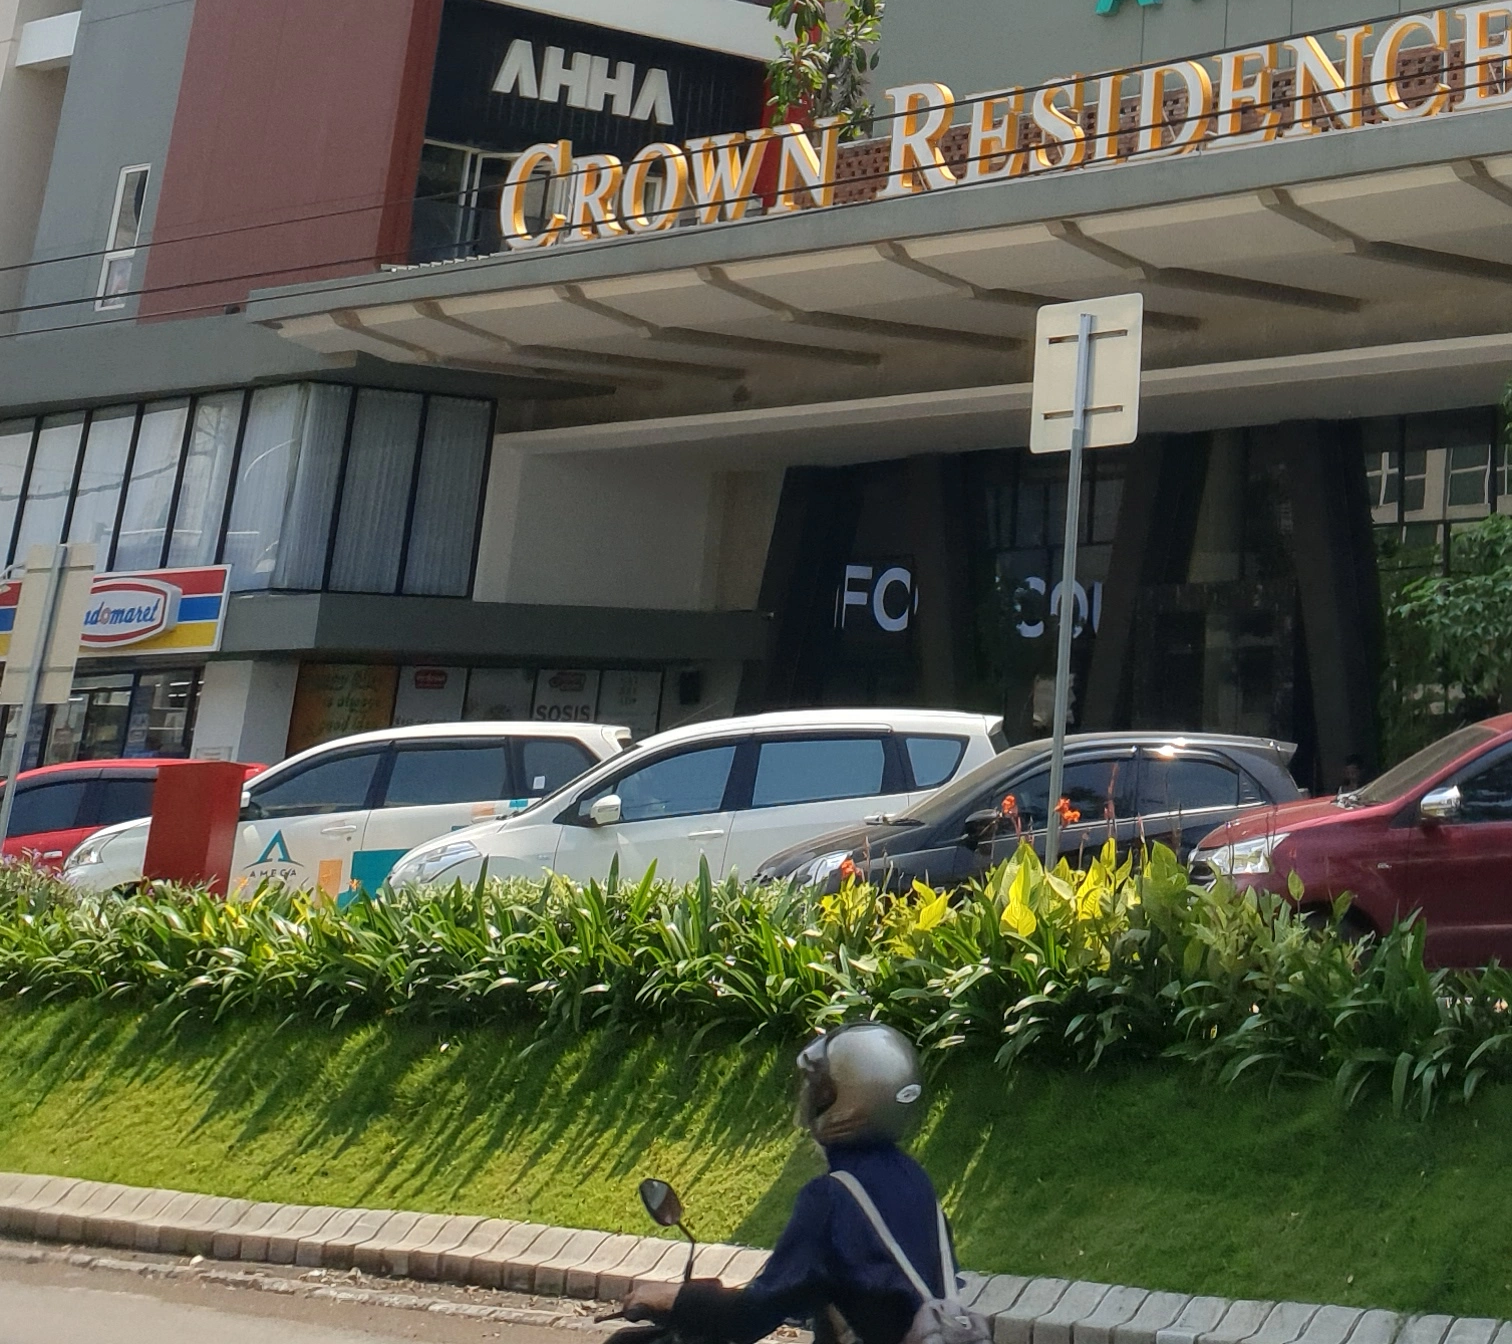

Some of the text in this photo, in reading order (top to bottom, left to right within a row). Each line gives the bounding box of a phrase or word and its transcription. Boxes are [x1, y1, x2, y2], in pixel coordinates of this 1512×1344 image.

[491, 38, 675, 126] AHHA
[500, 113, 847, 250] CROWN
[535, 704, 591, 721] SOSIS
